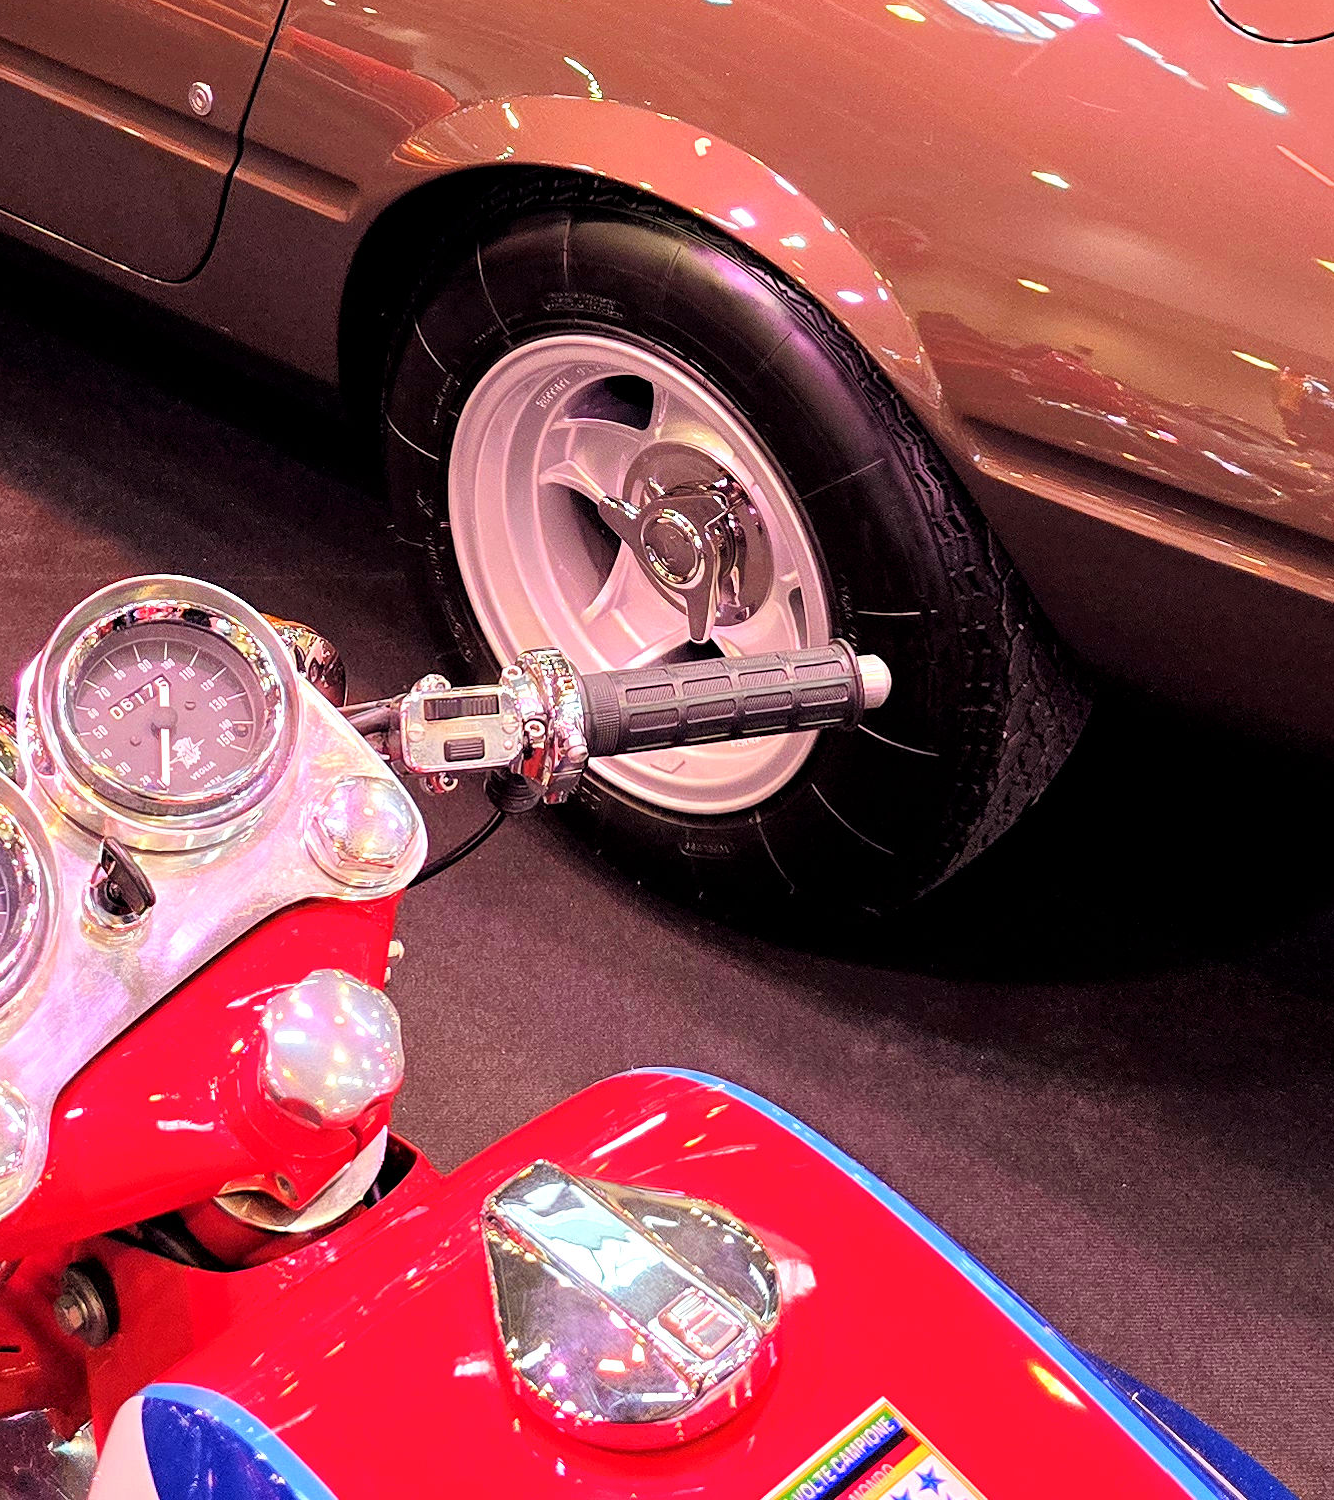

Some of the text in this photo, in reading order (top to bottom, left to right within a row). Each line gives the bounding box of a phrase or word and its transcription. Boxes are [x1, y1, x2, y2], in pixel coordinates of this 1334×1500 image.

[137, 657, 153, 673] 90
[160, 657, 176, 671] 100
[178, 665, 196, 681] 110
[94, 686, 111, 700] 70
[200, 679, 216, 692] 120
[208, 696, 228, 712] 130
[92, 724, 109, 739] 50
[216, 730, 236, 747] 150
[116, 761, 132, 777] 30
[791, 1413, 897, 1500] VOLTE CAMPIONE
